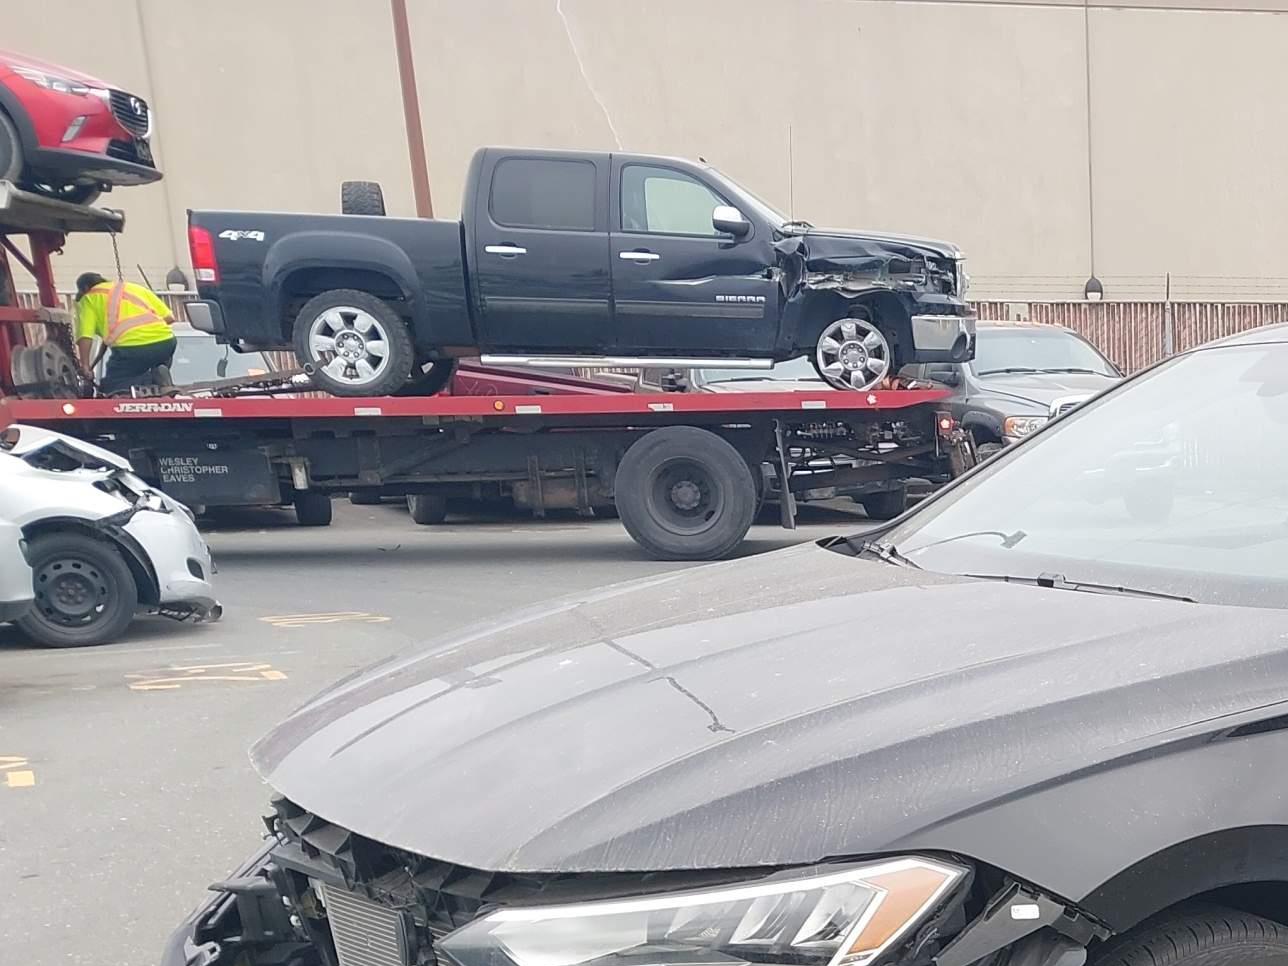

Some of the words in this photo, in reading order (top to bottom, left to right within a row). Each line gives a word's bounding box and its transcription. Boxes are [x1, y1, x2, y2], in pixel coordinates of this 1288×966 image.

[159, 457, 199, 466] WESLEY
[160, 465, 229, 474] CHRISTOPHER
[162, 474, 196, 483] EAVES
